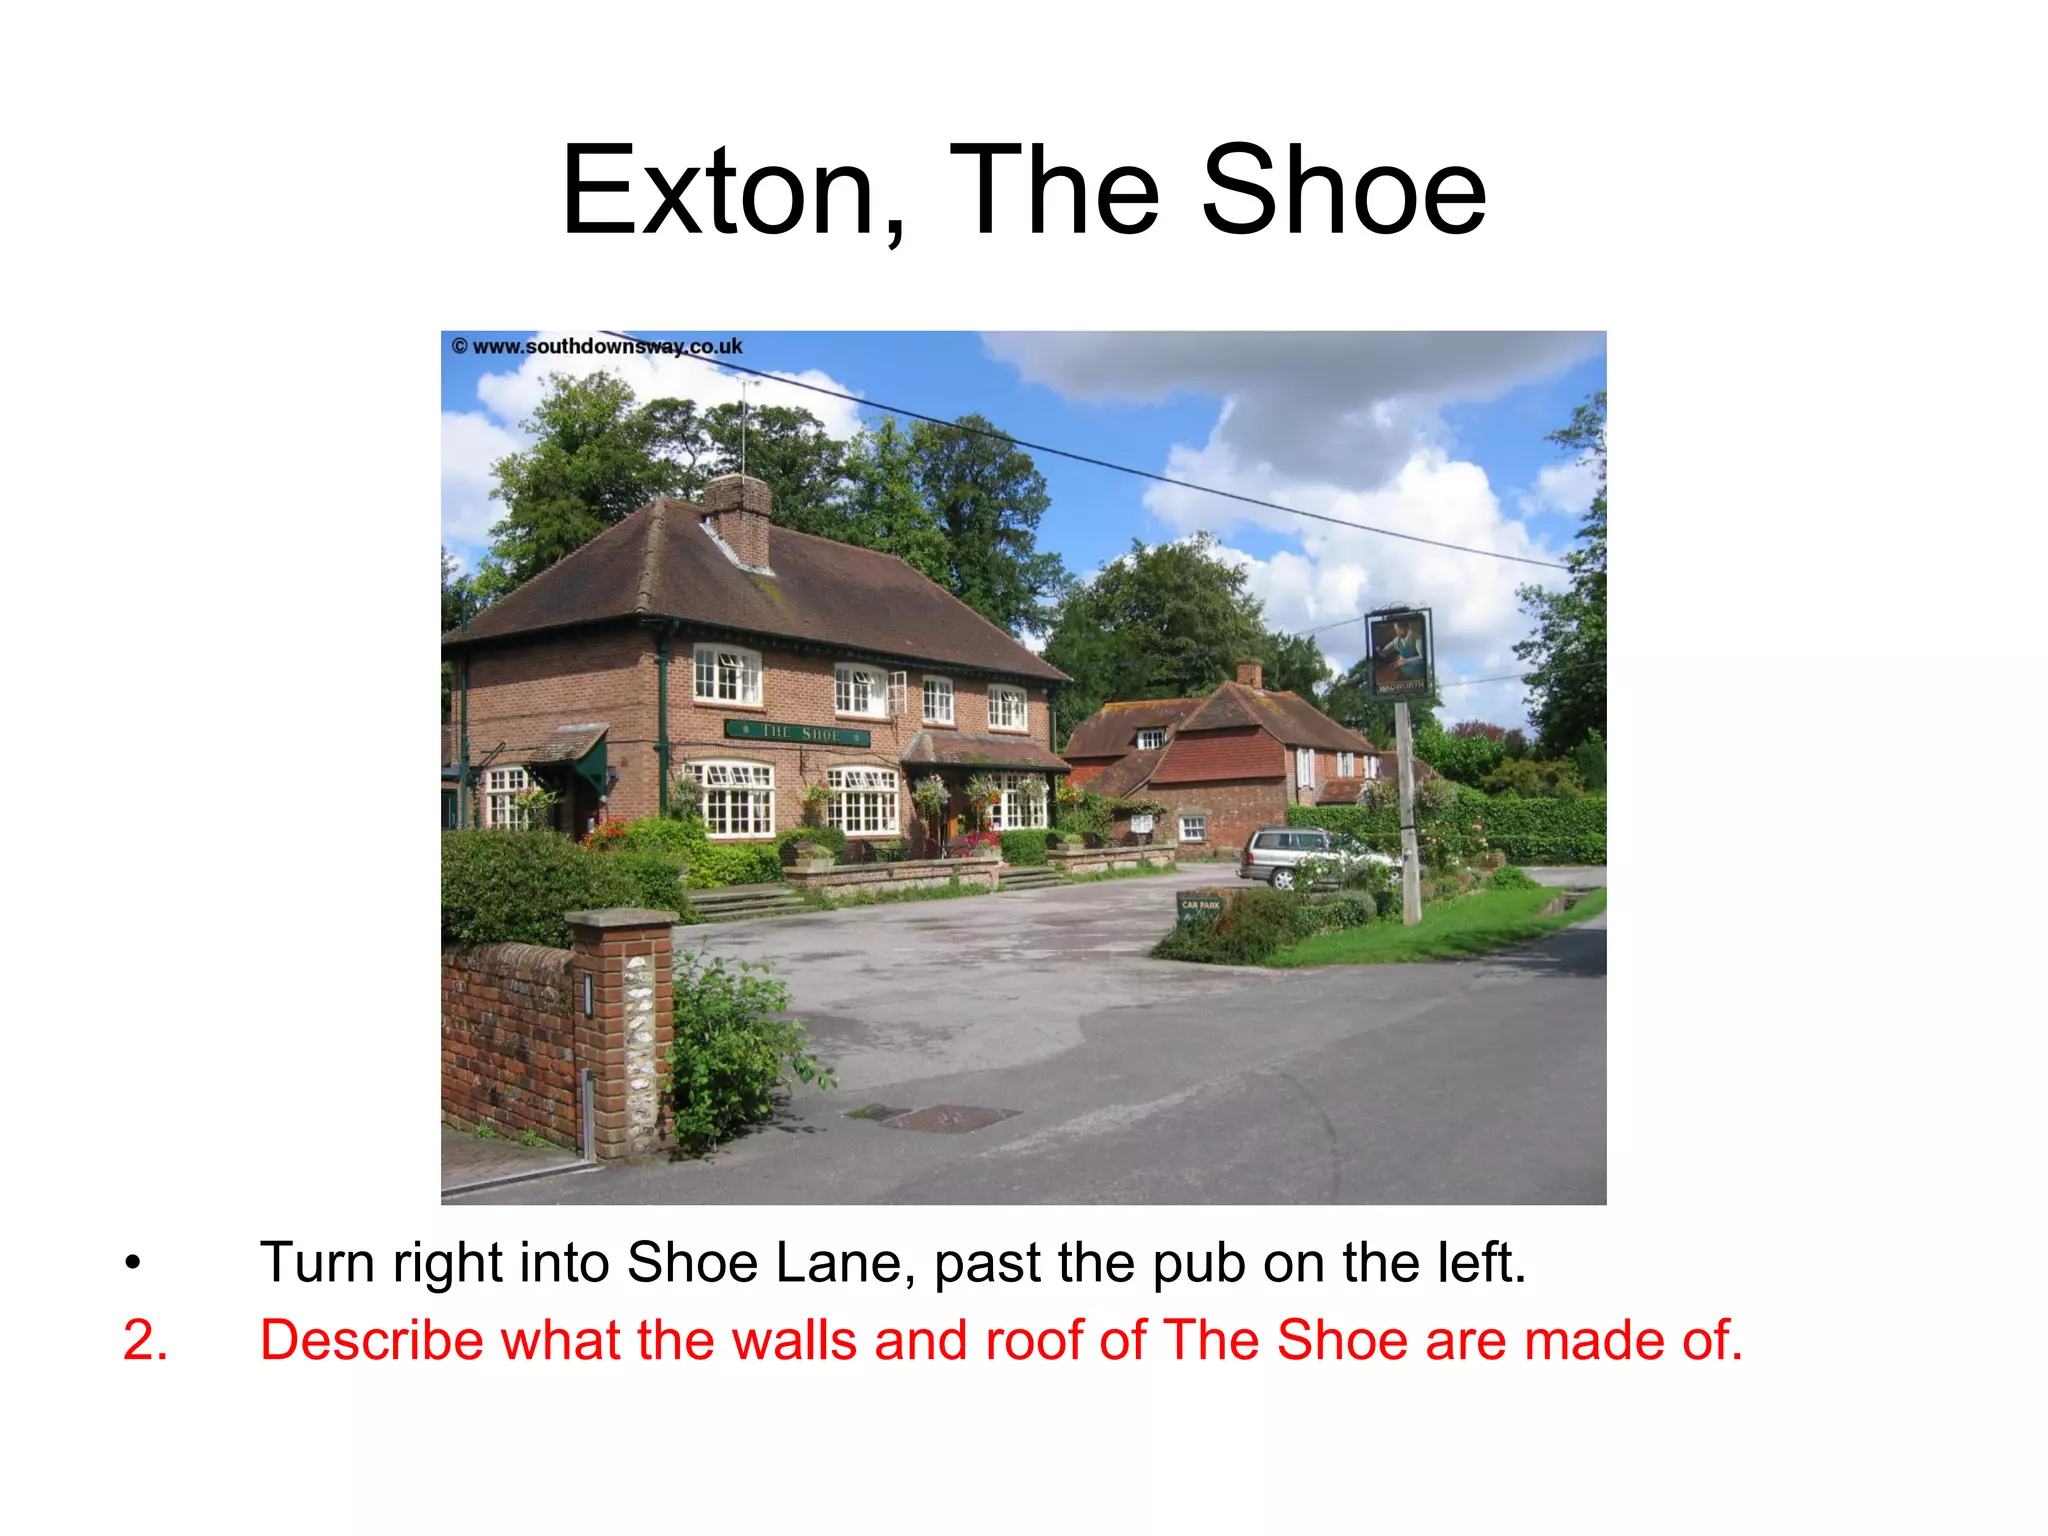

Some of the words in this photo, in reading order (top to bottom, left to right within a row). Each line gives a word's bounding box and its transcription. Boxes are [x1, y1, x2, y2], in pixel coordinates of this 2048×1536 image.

[764, 724, 791, 738] THE
[802, 727, 841, 742] SHOE
[1182, 901, 1198, 909] CAR
[1200, 901, 1220, 909] PARK
